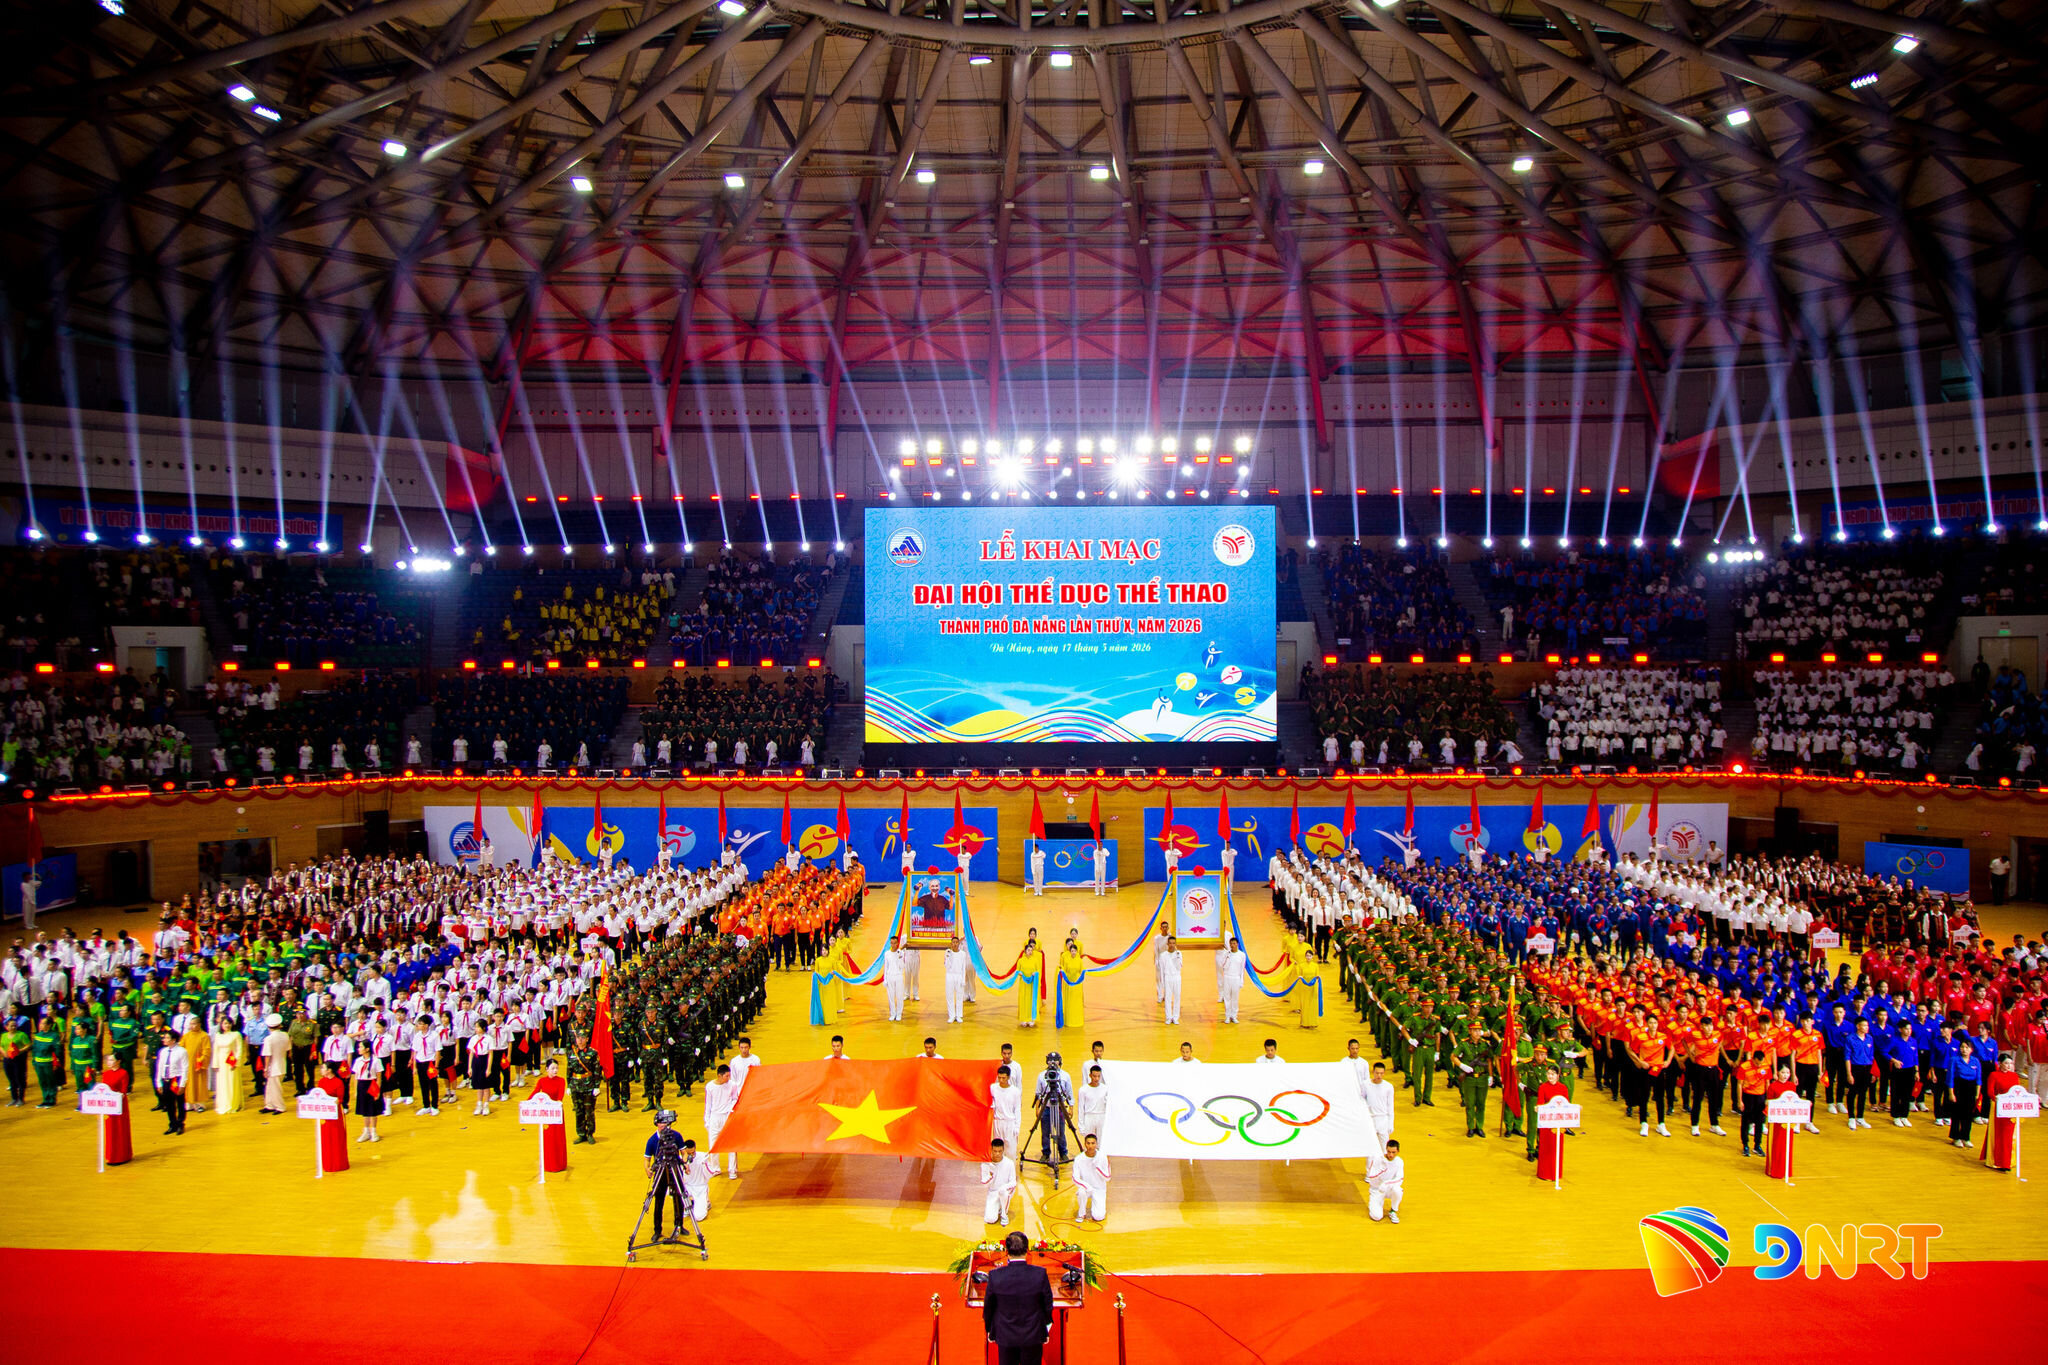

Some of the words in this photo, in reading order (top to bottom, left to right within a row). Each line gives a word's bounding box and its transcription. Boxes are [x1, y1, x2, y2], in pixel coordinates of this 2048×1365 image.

[980, 529, 1016, 561] LỄ
[1022, 540, 1094, 561] KHAI
[1099, 539, 1161, 565] MẠC
[913, 584, 954, 608] ĐẠI
[960, 580, 1002, 608] HỘI
[1009, 576, 1054, 604] THỂ
[1060, 583, 1109, 608] DỤC
[1116, 576, 1161, 604] THỂ
[1166, 582, 1228, 604] THAO
[939, 617, 980, 634] THÀNH
[984, 614, 1009, 634] PHỐ
[1012, 616, 1030, 634] ĐÀ
[1033, 615, 1067, 634] NẴNG
[1069, 614, 1092, 634] LẦN
[1095, 616, 1122, 634] THỨ
[1123, 618, 1135, 635] X,
[1138, 616, 1166, 634] NĂM
[1168, 618, 1202, 634] 2026
[1131, 642, 1151, 652] 2026
